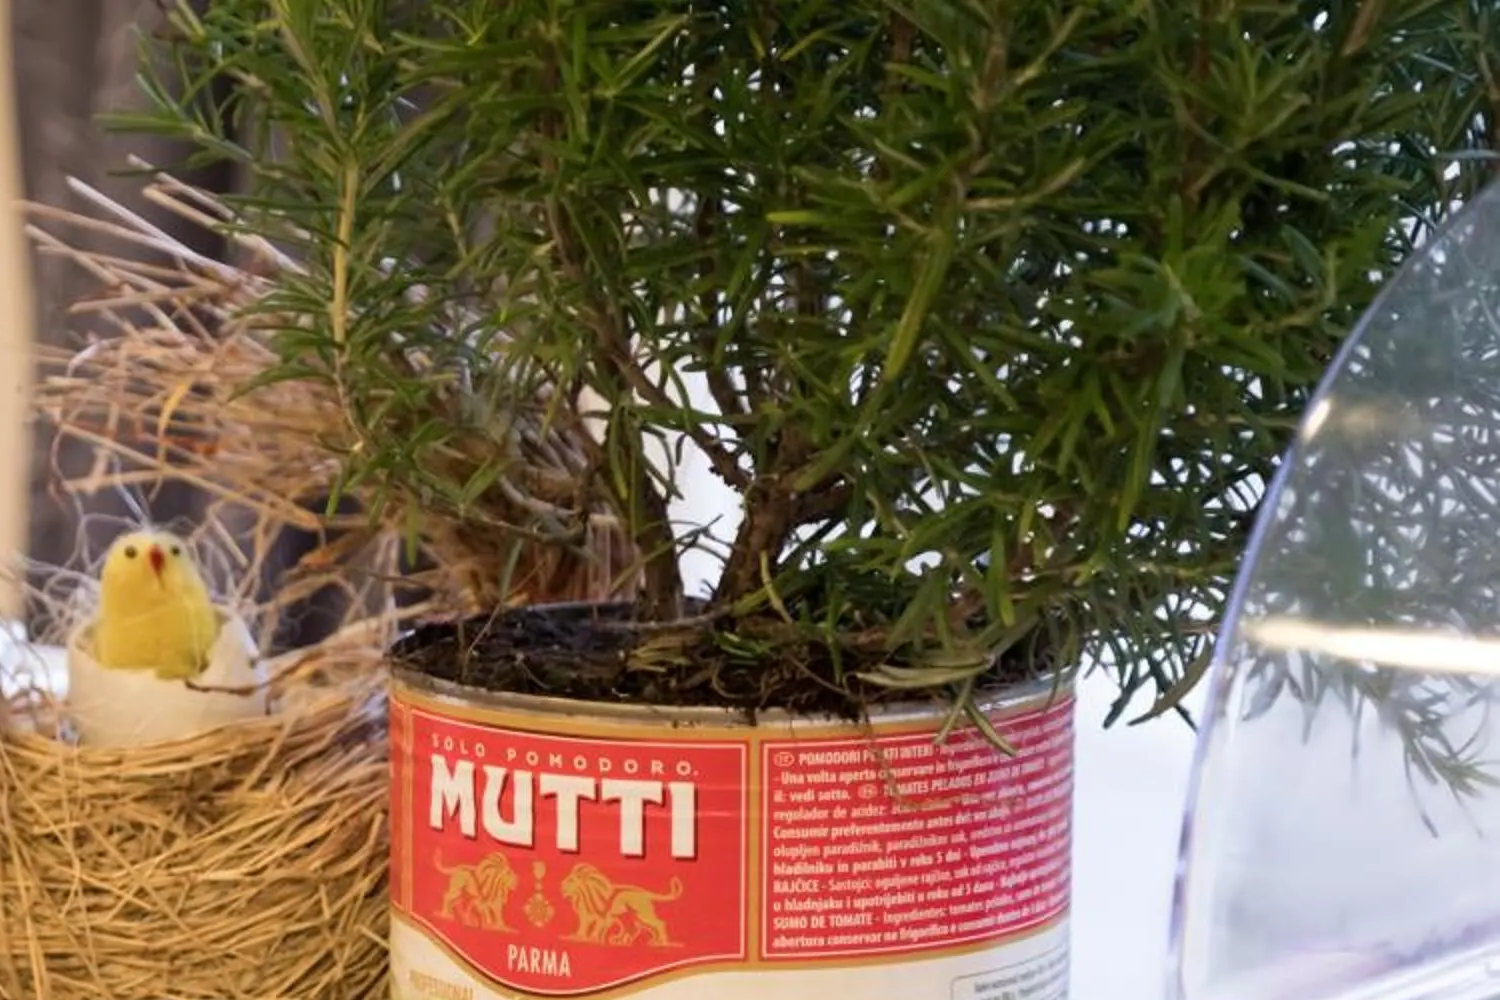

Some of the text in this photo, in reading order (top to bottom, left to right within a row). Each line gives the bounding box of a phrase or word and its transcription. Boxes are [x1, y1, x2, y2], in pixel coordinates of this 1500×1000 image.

[431, 732, 486, 758] SOLO
[798, 751, 861, 766] POMODORI
[781, 771, 804, 785] Una
[806, 769, 836, 784] volta
[789, 788, 815, 802] vedi
[429, 754, 698, 860] MUTTI
[832, 805, 847, 819] de
[837, 860, 849, 873] in
[773, 902, 781, 912] u
[811, 916, 826, 929] DE
[828, 913, 873, 929] TOMATE
[507, 943, 572, 977] PARMA
